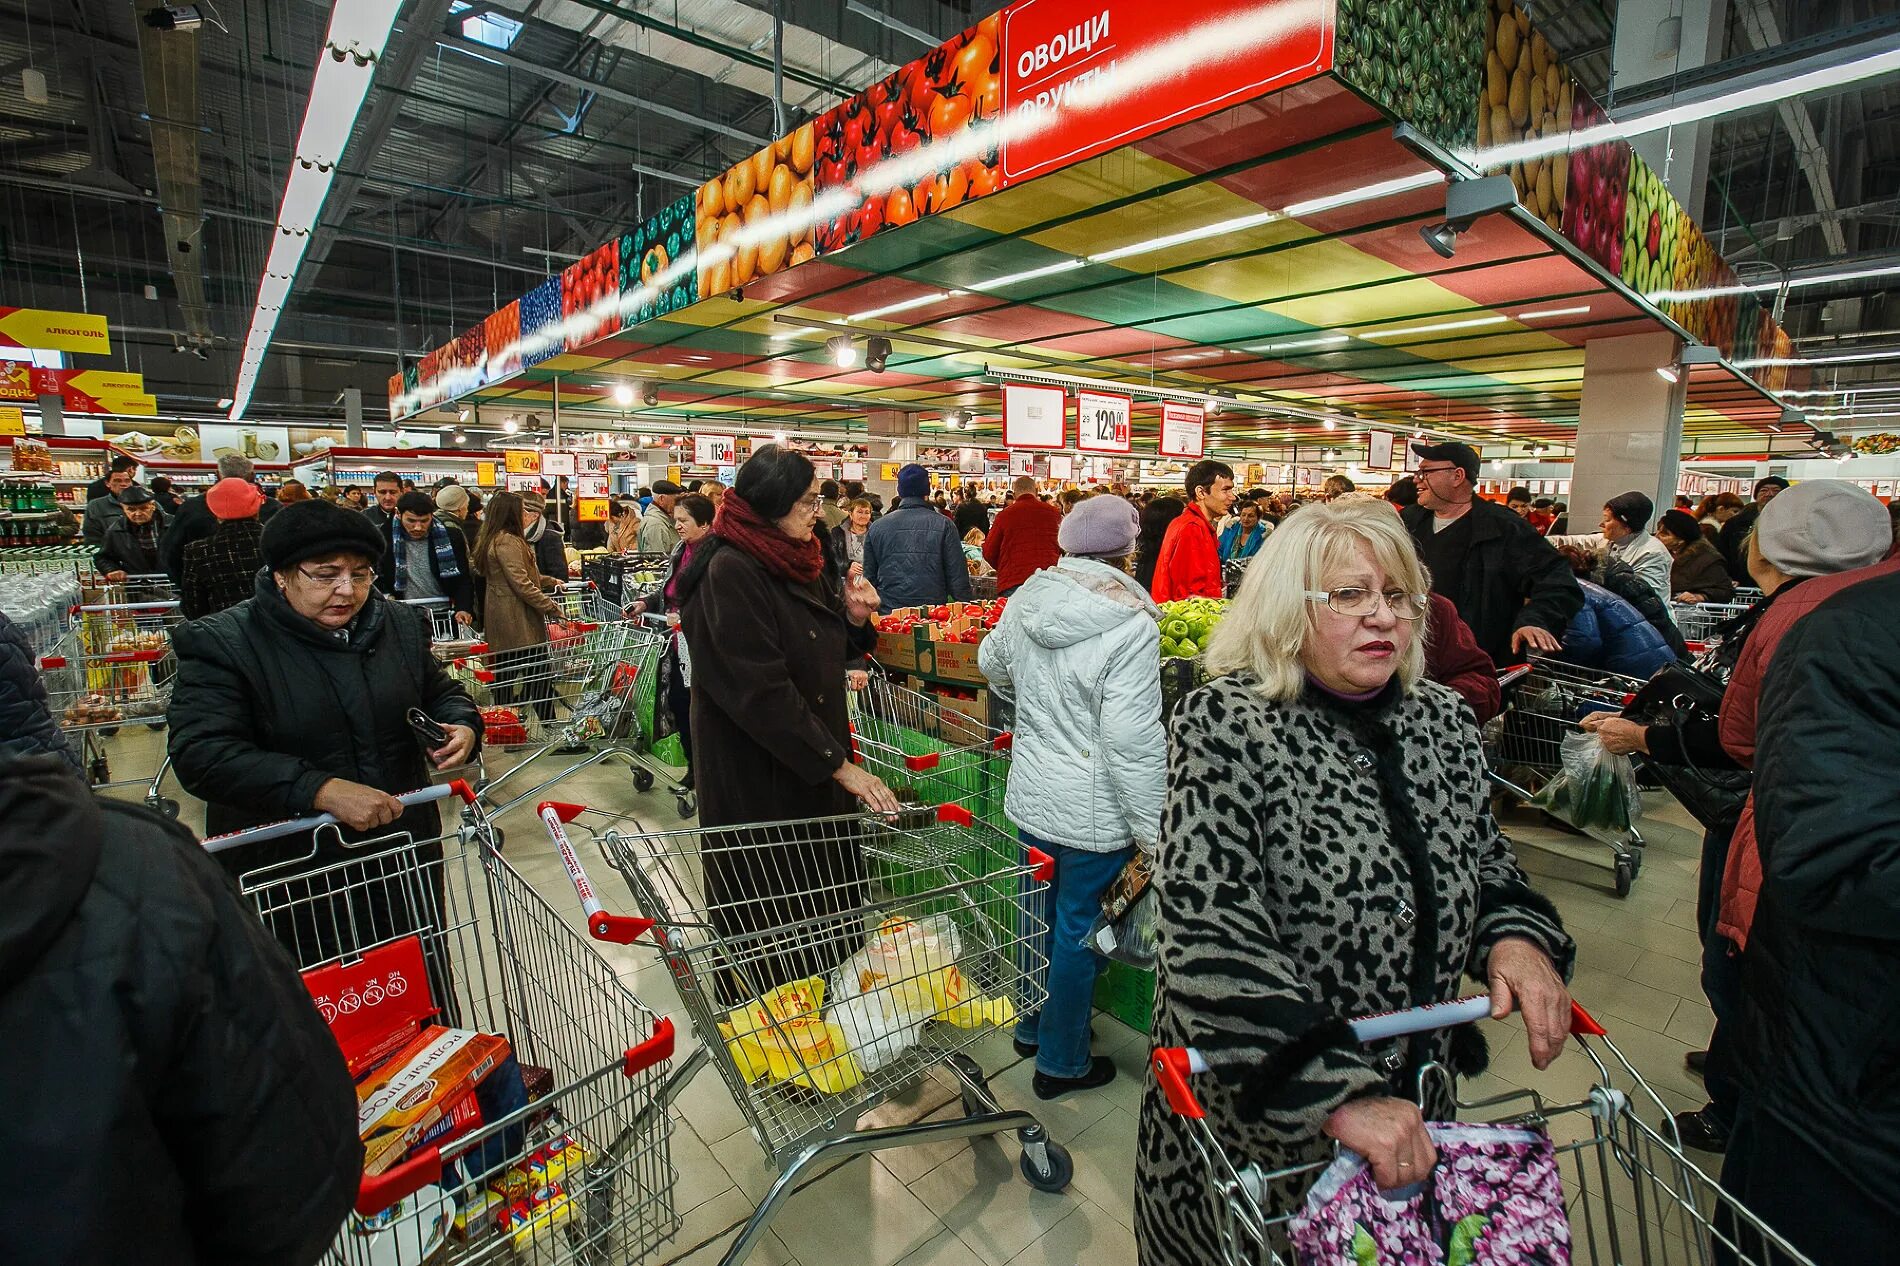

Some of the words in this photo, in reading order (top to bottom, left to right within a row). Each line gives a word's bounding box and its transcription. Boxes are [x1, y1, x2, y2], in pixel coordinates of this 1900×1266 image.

[1017, 9, 1109, 78] ОВОЩИ
[45, 326, 105, 338] АЛКОГОЛЬ
[1095, 409, 1115, 440] 129
[404, 1034, 462, 1081] РОДНЫЕ
[359, 1082, 407, 1125] ПРОСТ
